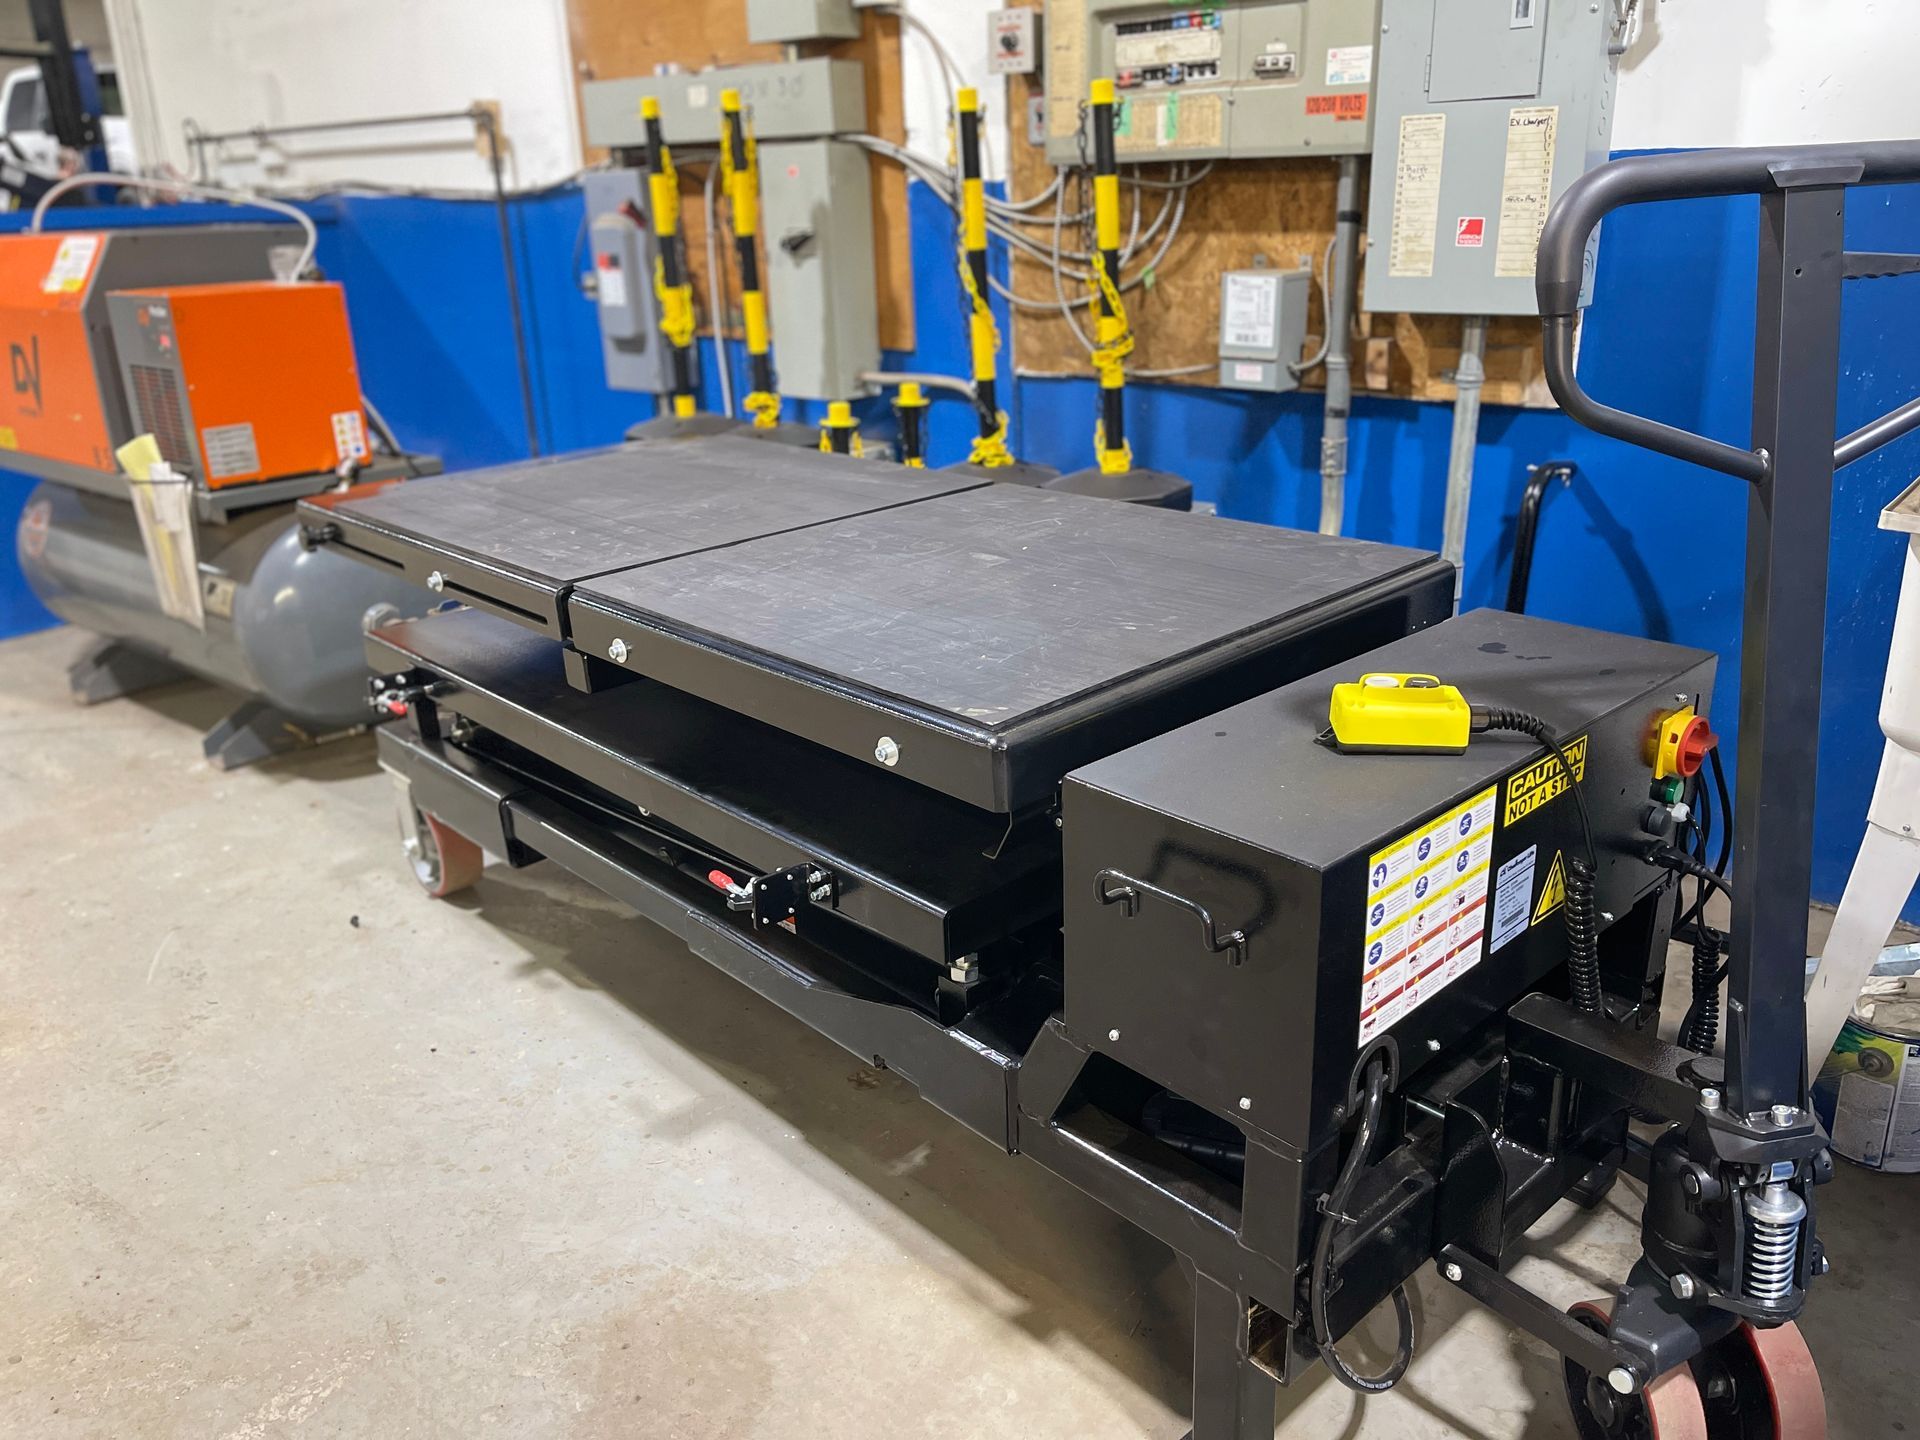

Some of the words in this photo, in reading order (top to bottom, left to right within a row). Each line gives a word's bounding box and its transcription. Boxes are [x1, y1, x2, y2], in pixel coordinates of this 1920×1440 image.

[1340, 94, 1363, 112] VOLTS
[1523, 117, 1547, 127] Charger
[1509, 794, 1536, 822] NOT
[1538, 787, 1547, 804] A
